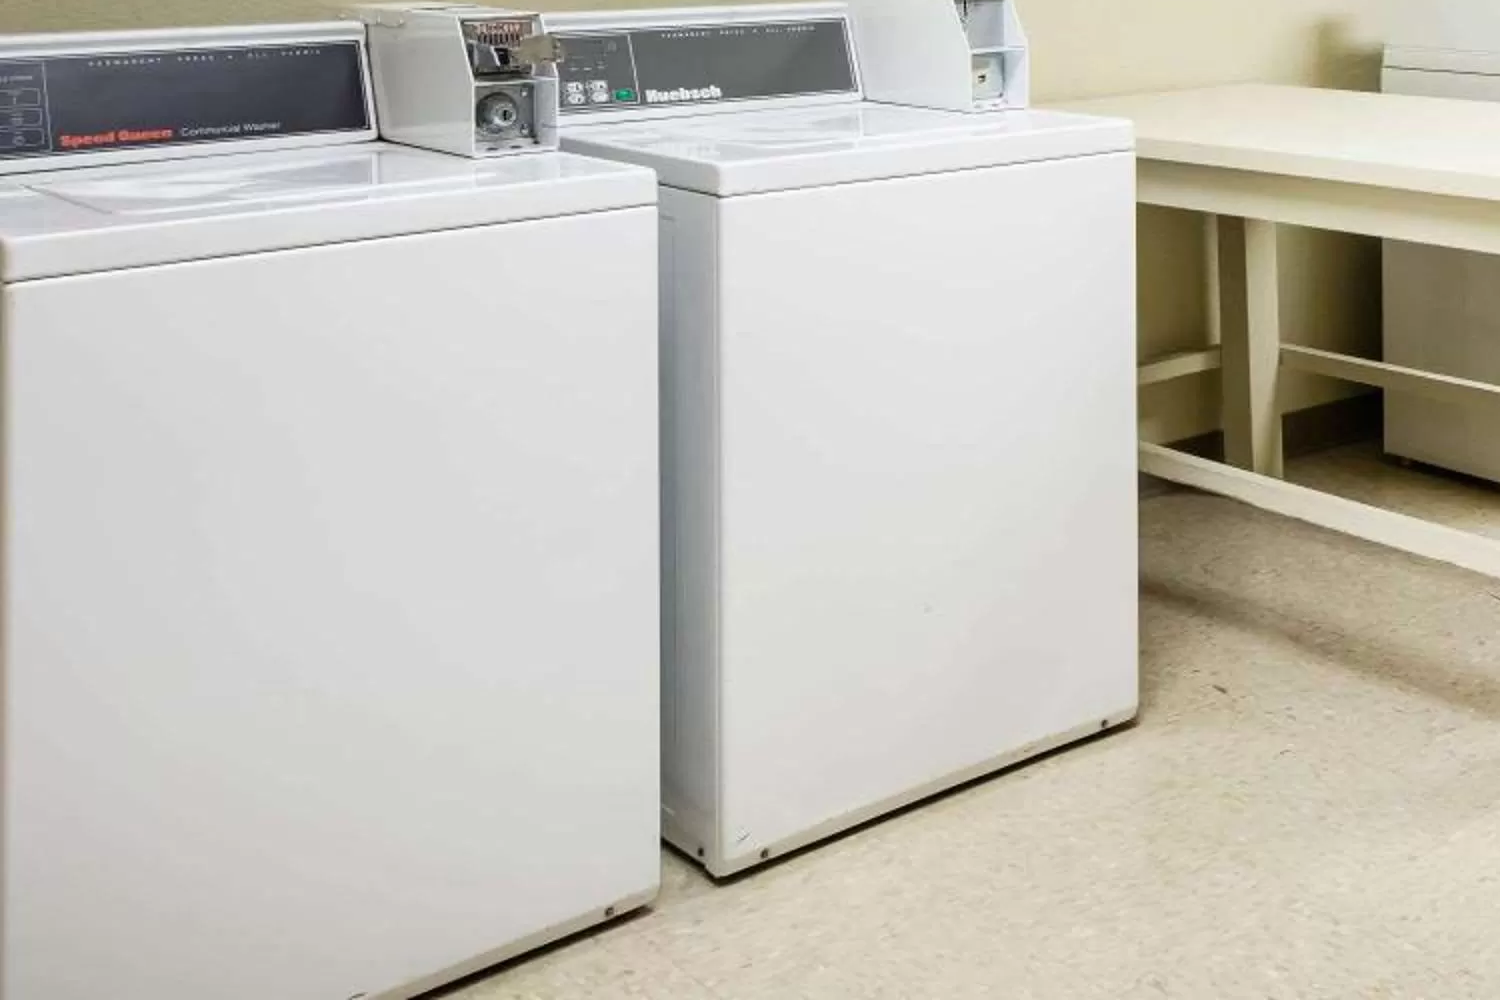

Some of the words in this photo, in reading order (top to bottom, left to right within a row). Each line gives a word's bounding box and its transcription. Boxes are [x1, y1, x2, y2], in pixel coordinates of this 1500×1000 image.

[645, 84, 722, 103] Huebsch
[60, 131, 115, 148] Speed
[118, 128, 173, 142] Queen
